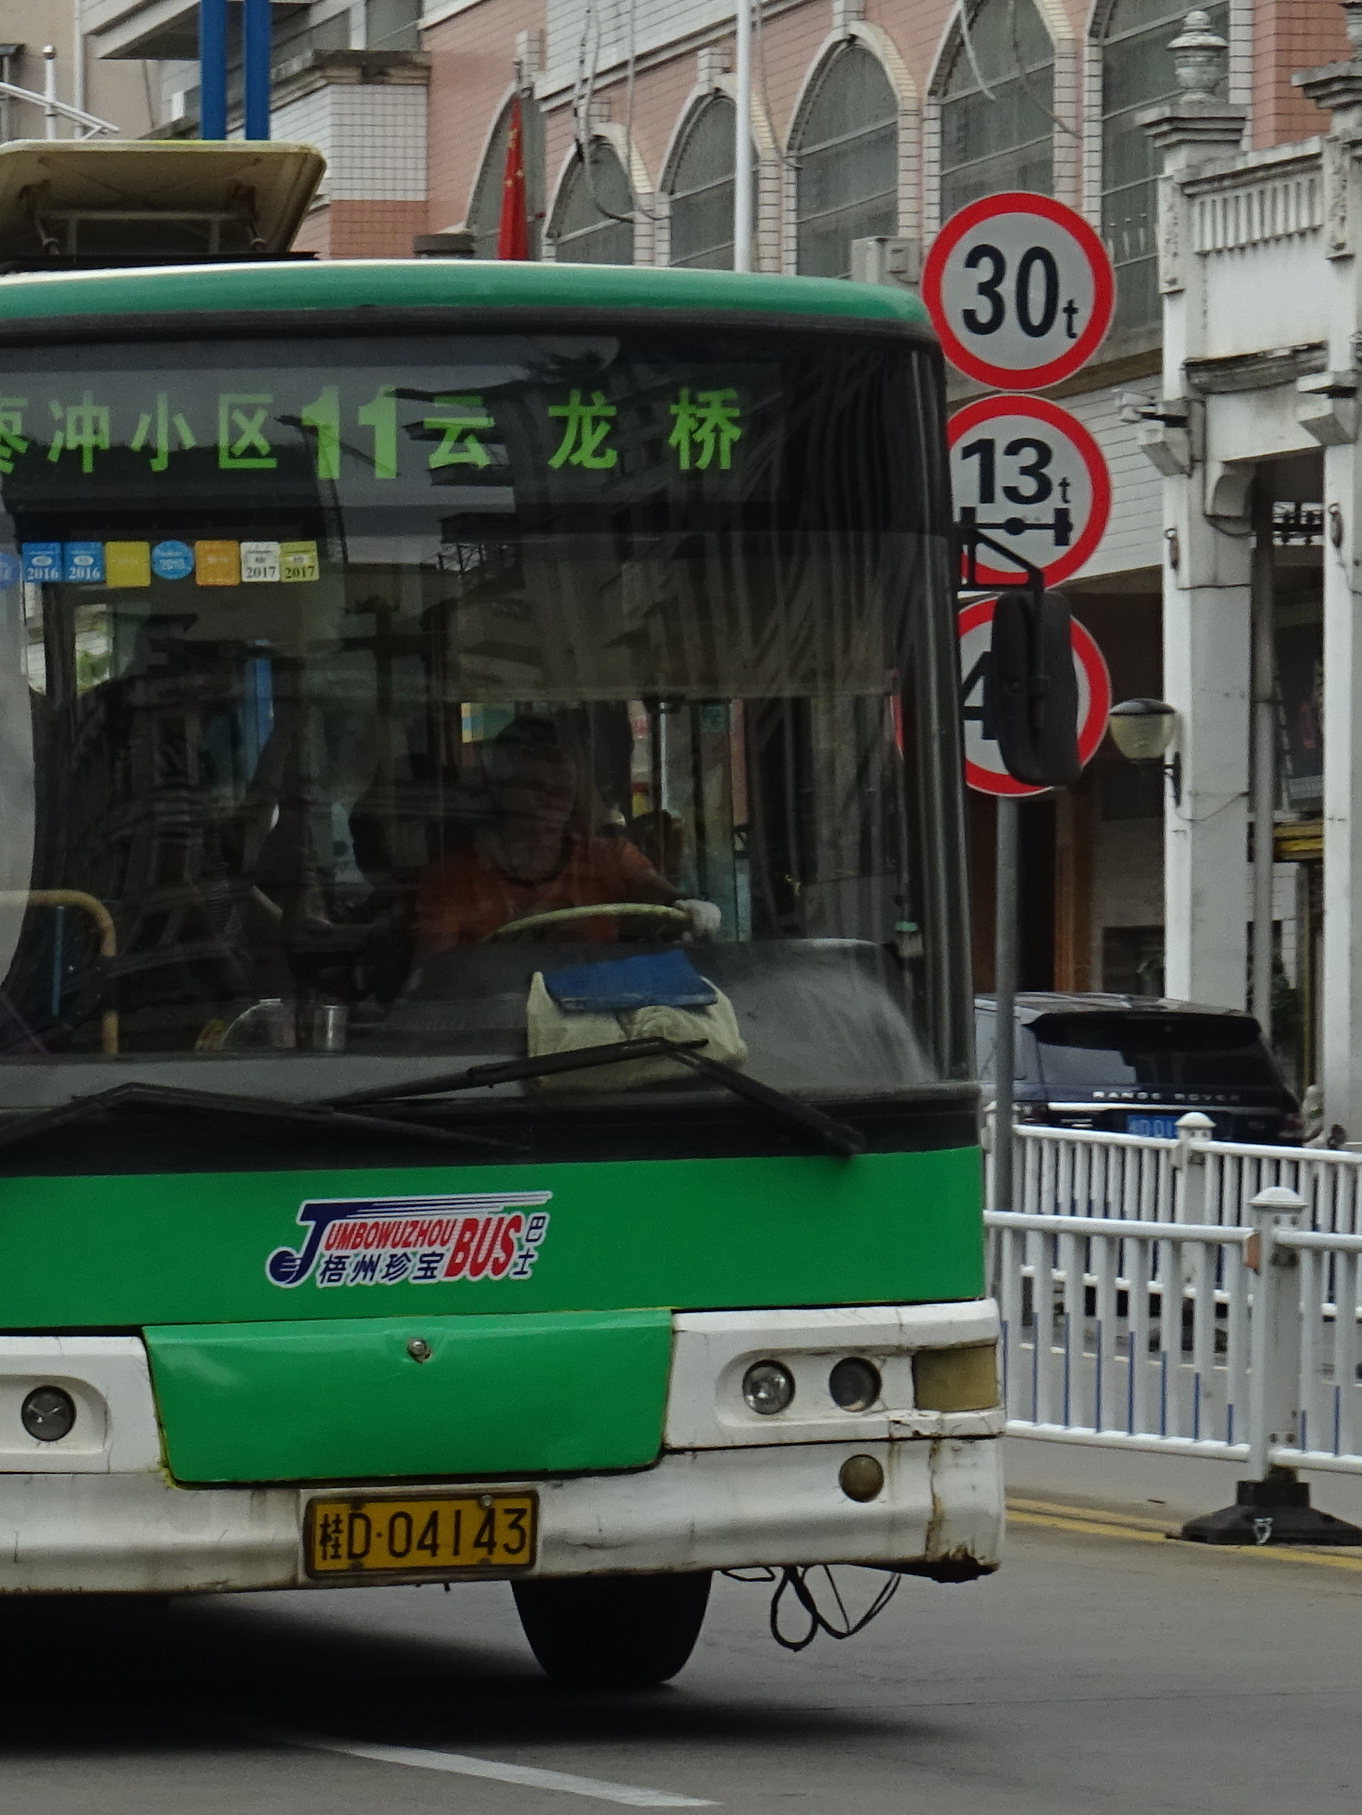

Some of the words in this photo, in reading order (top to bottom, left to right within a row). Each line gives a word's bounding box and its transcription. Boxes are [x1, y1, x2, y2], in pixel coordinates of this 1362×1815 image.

[962, 243, 1080, 340] 30t
[301, 385, 399, 480] 11
[426, 387, 742, 472] 云龙桥
[960, 437, 1072, 506] 13t
[26, 567, 59, 581] 2016
[68, 567, 101, 581] 2016
[245, 566, 278, 579] 2017
[284, 566, 316, 579] 2017
[1092, 1090, 1163, 1101] RANGE
[446, 1214, 522, 1277] BUS
[318, 1252, 446, 1284] 梧州珍宝
